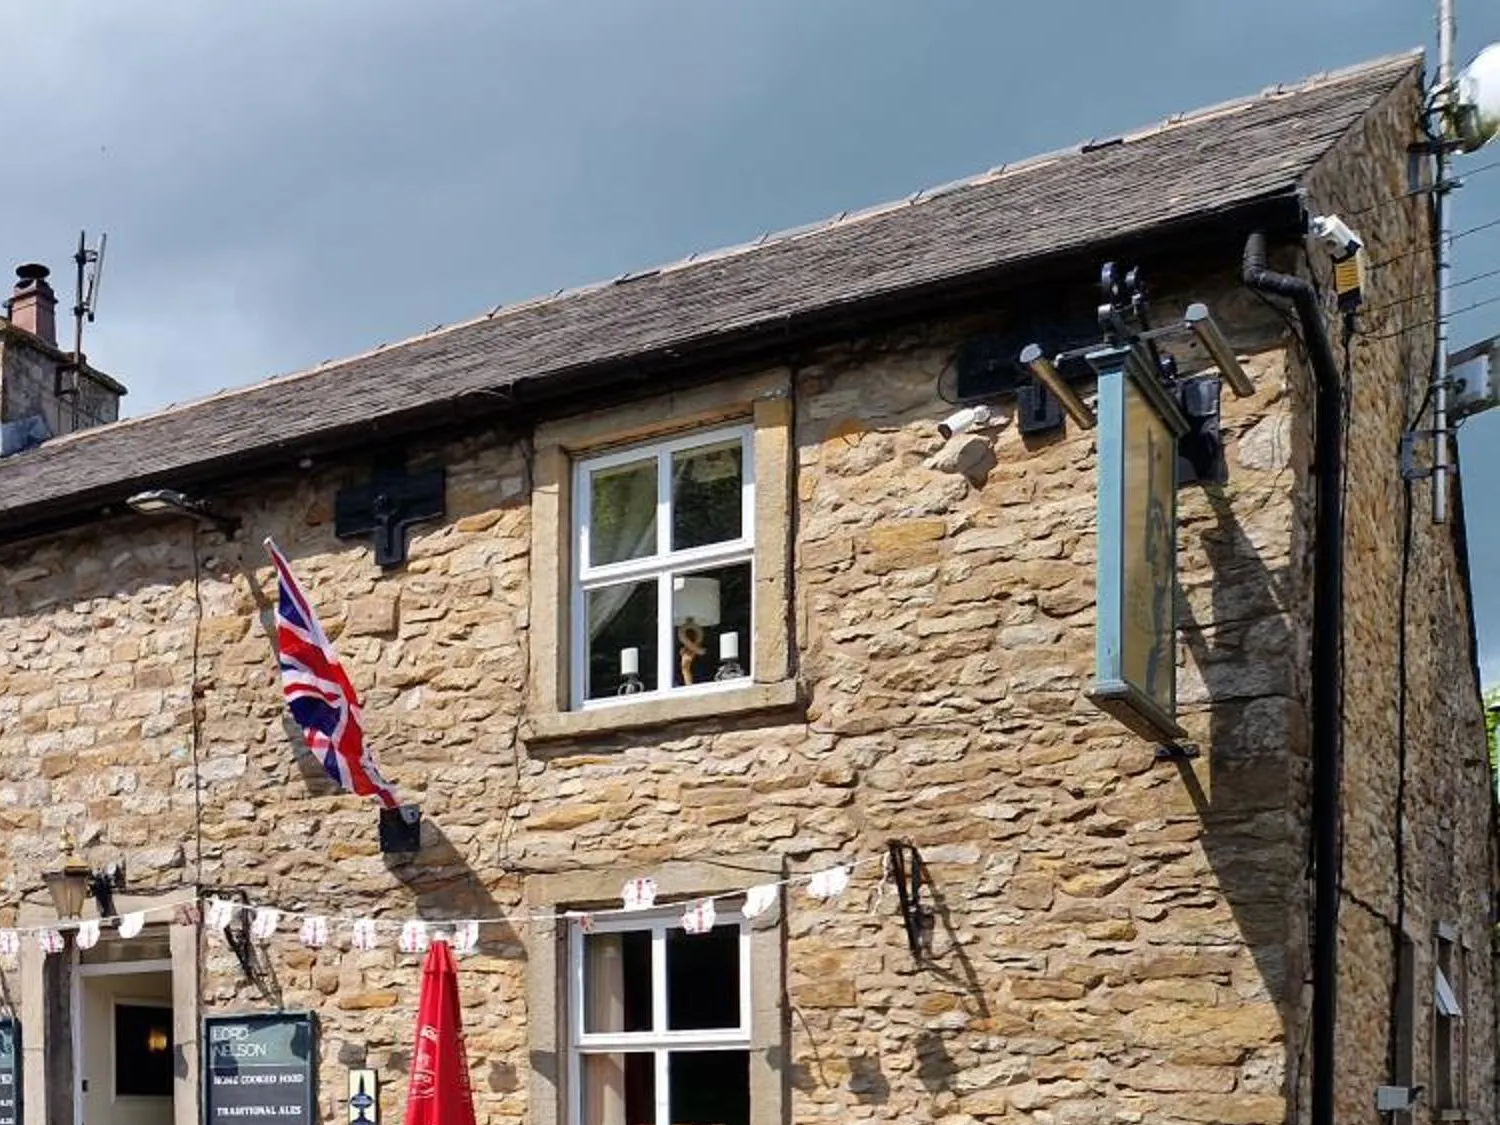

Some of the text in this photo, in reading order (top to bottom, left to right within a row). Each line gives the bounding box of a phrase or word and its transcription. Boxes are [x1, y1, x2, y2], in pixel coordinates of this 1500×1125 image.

[213, 1026, 249, 1041] LORD
[213, 1043, 268, 1057] NELSON
[213, 1073, 304, 1085] HOME COOKED FOOD
[216, 1105, 302, 1117] TRADITIONAL ALES
